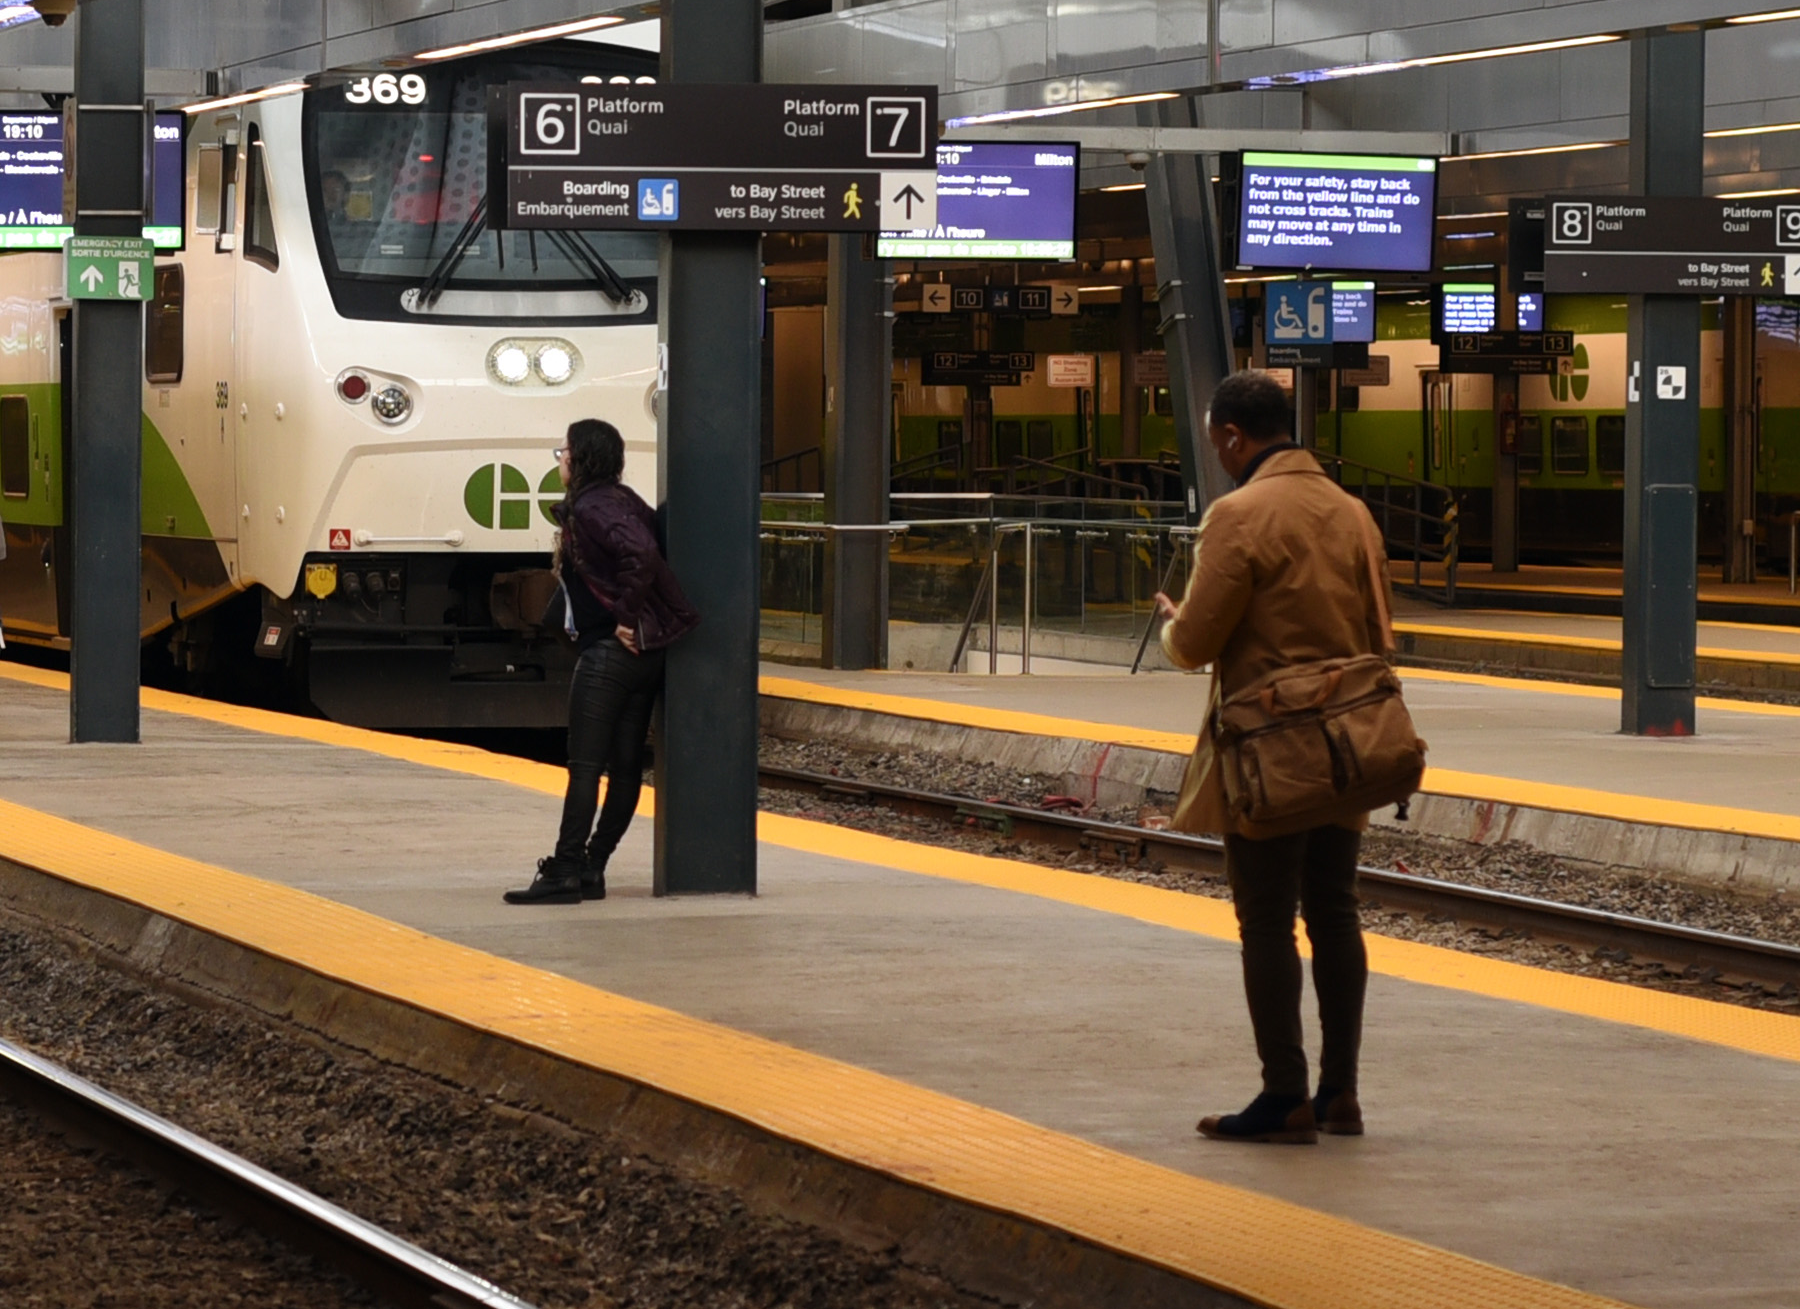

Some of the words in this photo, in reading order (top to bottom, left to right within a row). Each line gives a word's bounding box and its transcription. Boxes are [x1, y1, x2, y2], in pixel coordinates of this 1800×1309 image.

[346, 74, 426, 104] 369
[587, 98, 664, 114] Platform
[783, 100, 860, 116] Platform
[535, 103, 565, 144] 6
[587, 119, 628, 137] Quai
[783, 121, 824, 139] Quai
[883, 107, 909, 147] 7
[3, 125, 43, 138] 19:10
[1035, 153, 1073, 166] Milton
[563, 181, 630, 197] Boarding
[1250, 174, 1271, 186] For
[1273, 175, 1302, 188] your
[1305, 176, 1348, 190] safety,
[1351, 177, 1378, 190] stay
[1380, 178, 1410, 190] back
[730, 184, 746, 199] to
[750, 185, 777, 203] Bay
[781, 184, 825, 199] Street
[1249, 188, 1279, 200] from
[1282, 189, 1303, 201] the
[1306, 191, 1348, 204] yellow
[1351, 192, 1374, 204] line
[1376, 192, 1400, 204] and
[1403, 193, 1420, 205] do
[16, 209, 27, 224] À
[517, 201, 629, 219] Embarquement
[715, 206, 746, 219] vers
[750, 205, 777, 223] Bay
[781, 204, 825, 219] Street
[1248, 204, 1270, 214] not
[1272, 205, 1306, 216] cross
[1309, 205, 1351, 217] tracks.
[1354, 206, 1394, 218] Trains
[1596, 206, 1646, 217] Platform
[1723, 207, 1773, 218] Platform
[1248, 219, 1275, 231] may
[1278, 220, 1313, 231] move
[1315, 221, 1329, 231] at
[1331, 222, 1355, 234] any
[1357, 221, 1386, 233] time
[1388, 222, 1402, 233] in
[1562, 209, 1582, 237] 8
[1596, 220, 1623, 231] Quai
[1723, 221, 1750, 232] Quai
[935, 224, 944, 238] À
[947, 227, 985, 238] l'heure
[1247, 234, 1271, 246] any
[1273, 233, 1333, 246] direction.
[72, 250, 101, 258] SORTIE
[104, 250, 150, 258] D'URGENCE
[1688, 263, 1698, 272] to
[1701, 263, 1719, 275] Bay
[1721, 263, 1750, 273] Street
[1678, 278, 1698, 286] vers
[1701, 277, 1719, 289] Bay
[1721, 277, 1750, 286] Street
[961, 292, 976, 305] 10
[1027, 293, 1039, 306] 11
[1458, 337, 1473, 350] 12
[1549, 337, 1564, 350] 13
[940, 356, 952, 366] 12
[1014, 356, 1027, 366] 13
